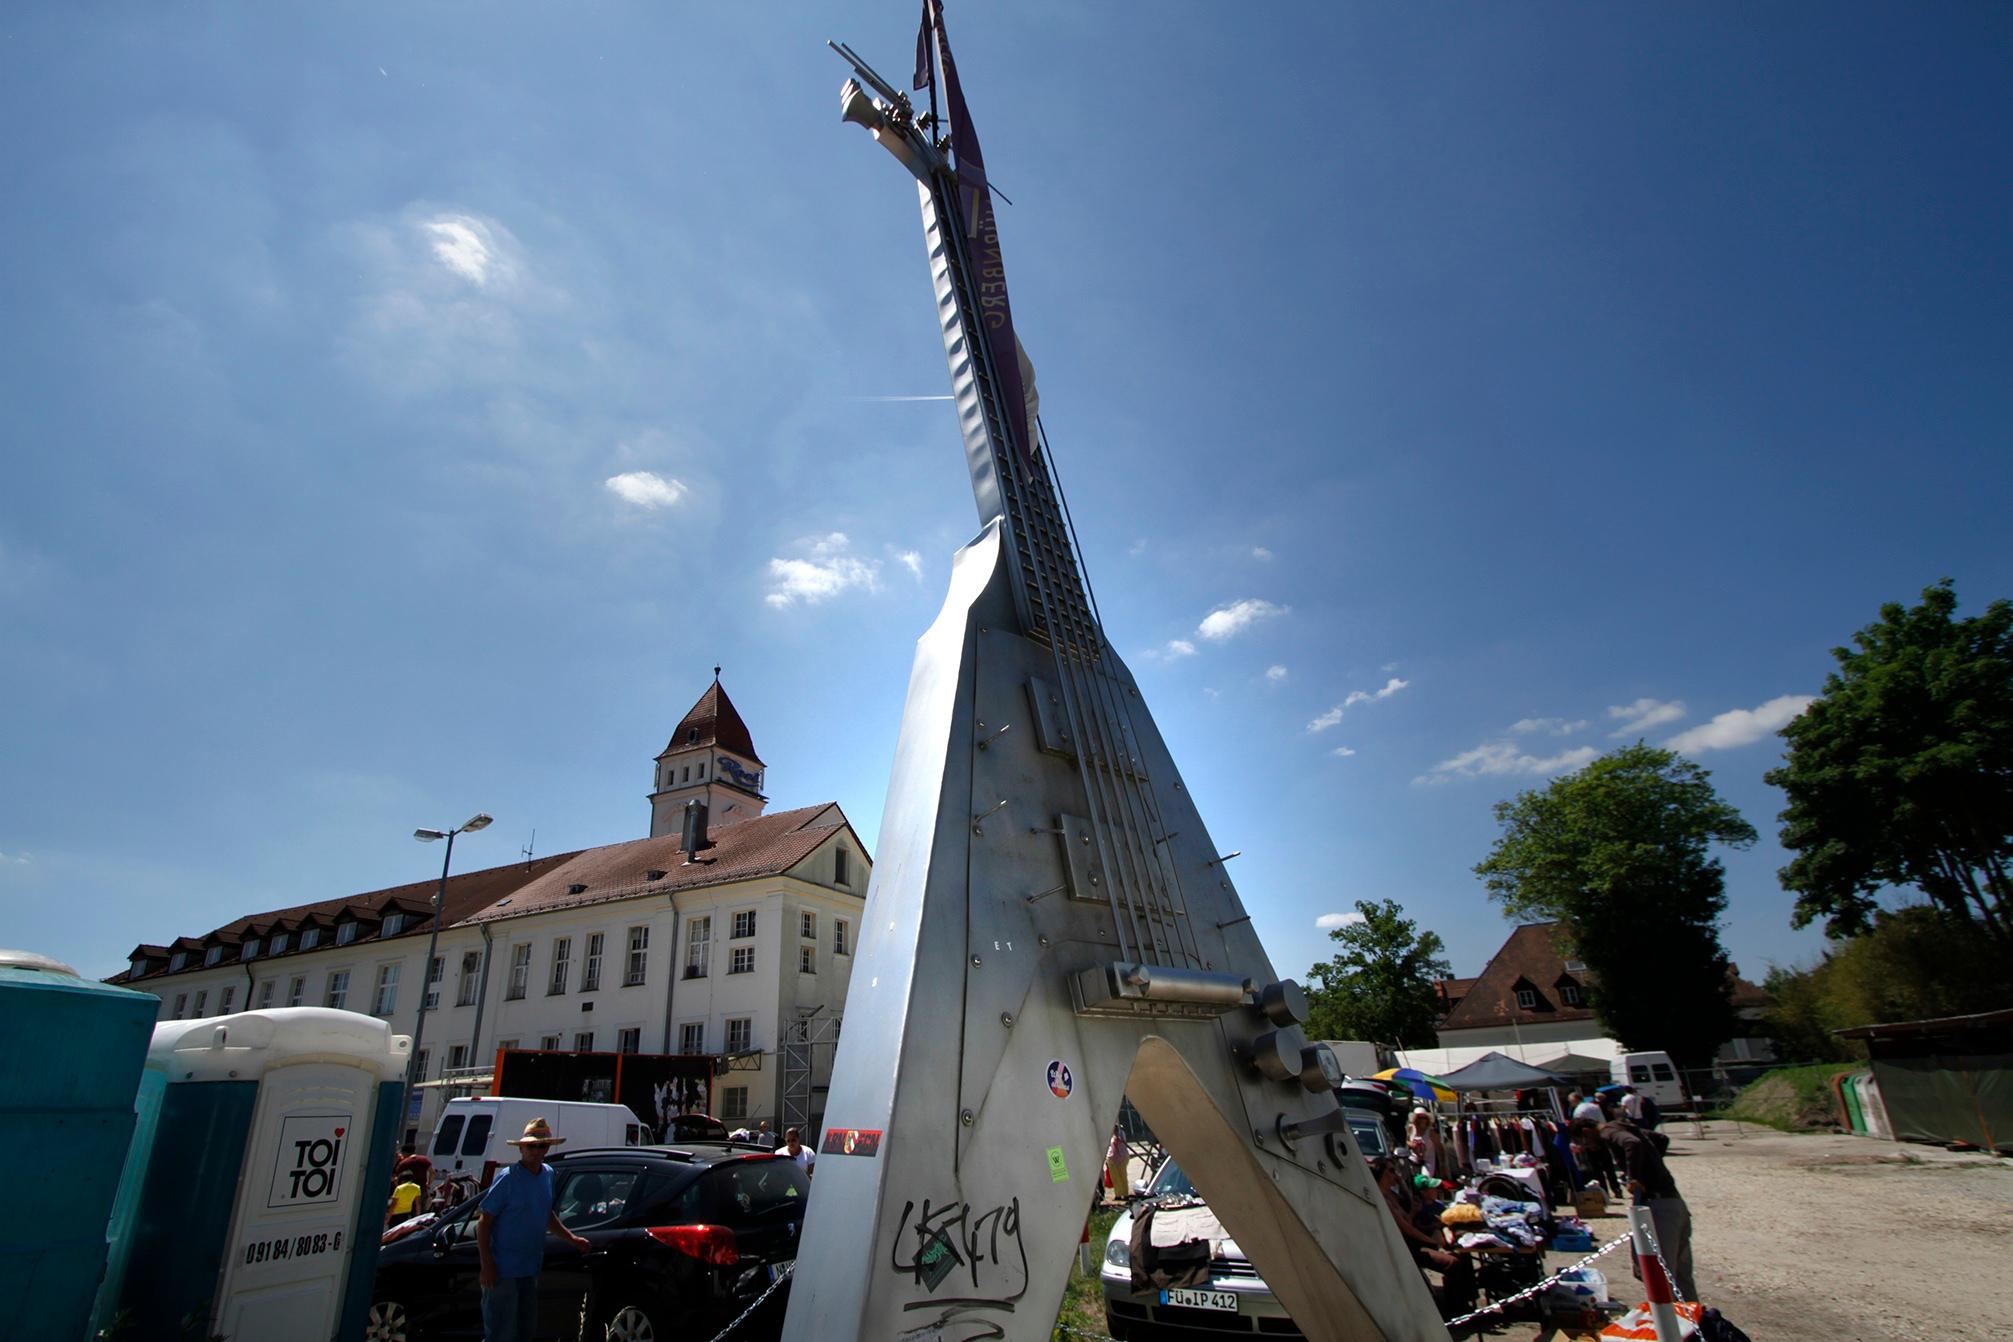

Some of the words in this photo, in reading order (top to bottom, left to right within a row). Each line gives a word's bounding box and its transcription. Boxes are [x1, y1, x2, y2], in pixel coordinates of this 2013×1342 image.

[289, 1168, 336, 1198] TOI
[1167, 1290, 1184, 1304] FÜ
[1193, 1293, 1208, 1306] IP
[1211, 1294, 1235, 1309] 412
